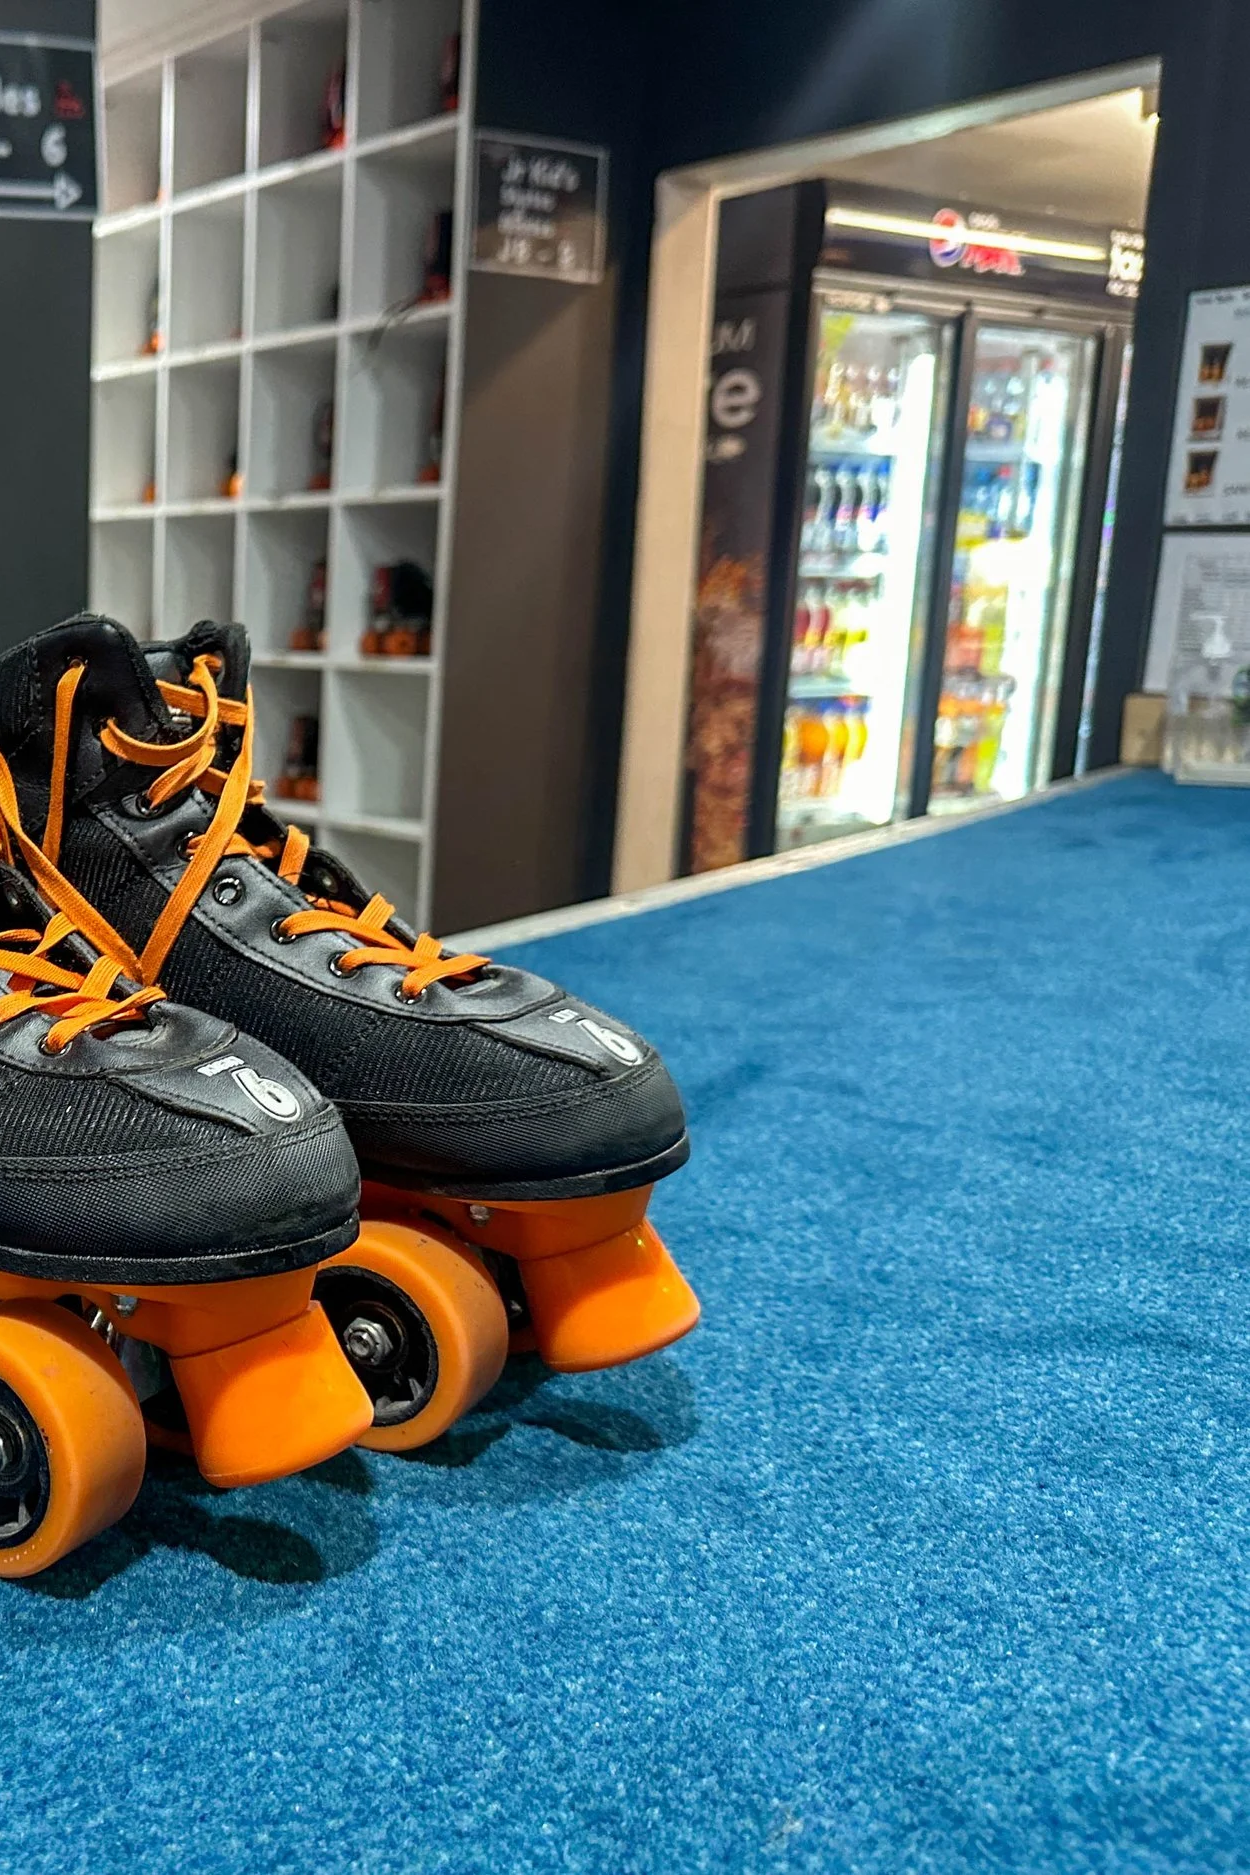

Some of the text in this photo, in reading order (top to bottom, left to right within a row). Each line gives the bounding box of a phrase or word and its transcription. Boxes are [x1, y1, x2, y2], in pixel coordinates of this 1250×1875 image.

[41, 122, 68, 167] 6
[576, 1019, 643, 1066] 6
[231, 1067, 301, 1122] 6
